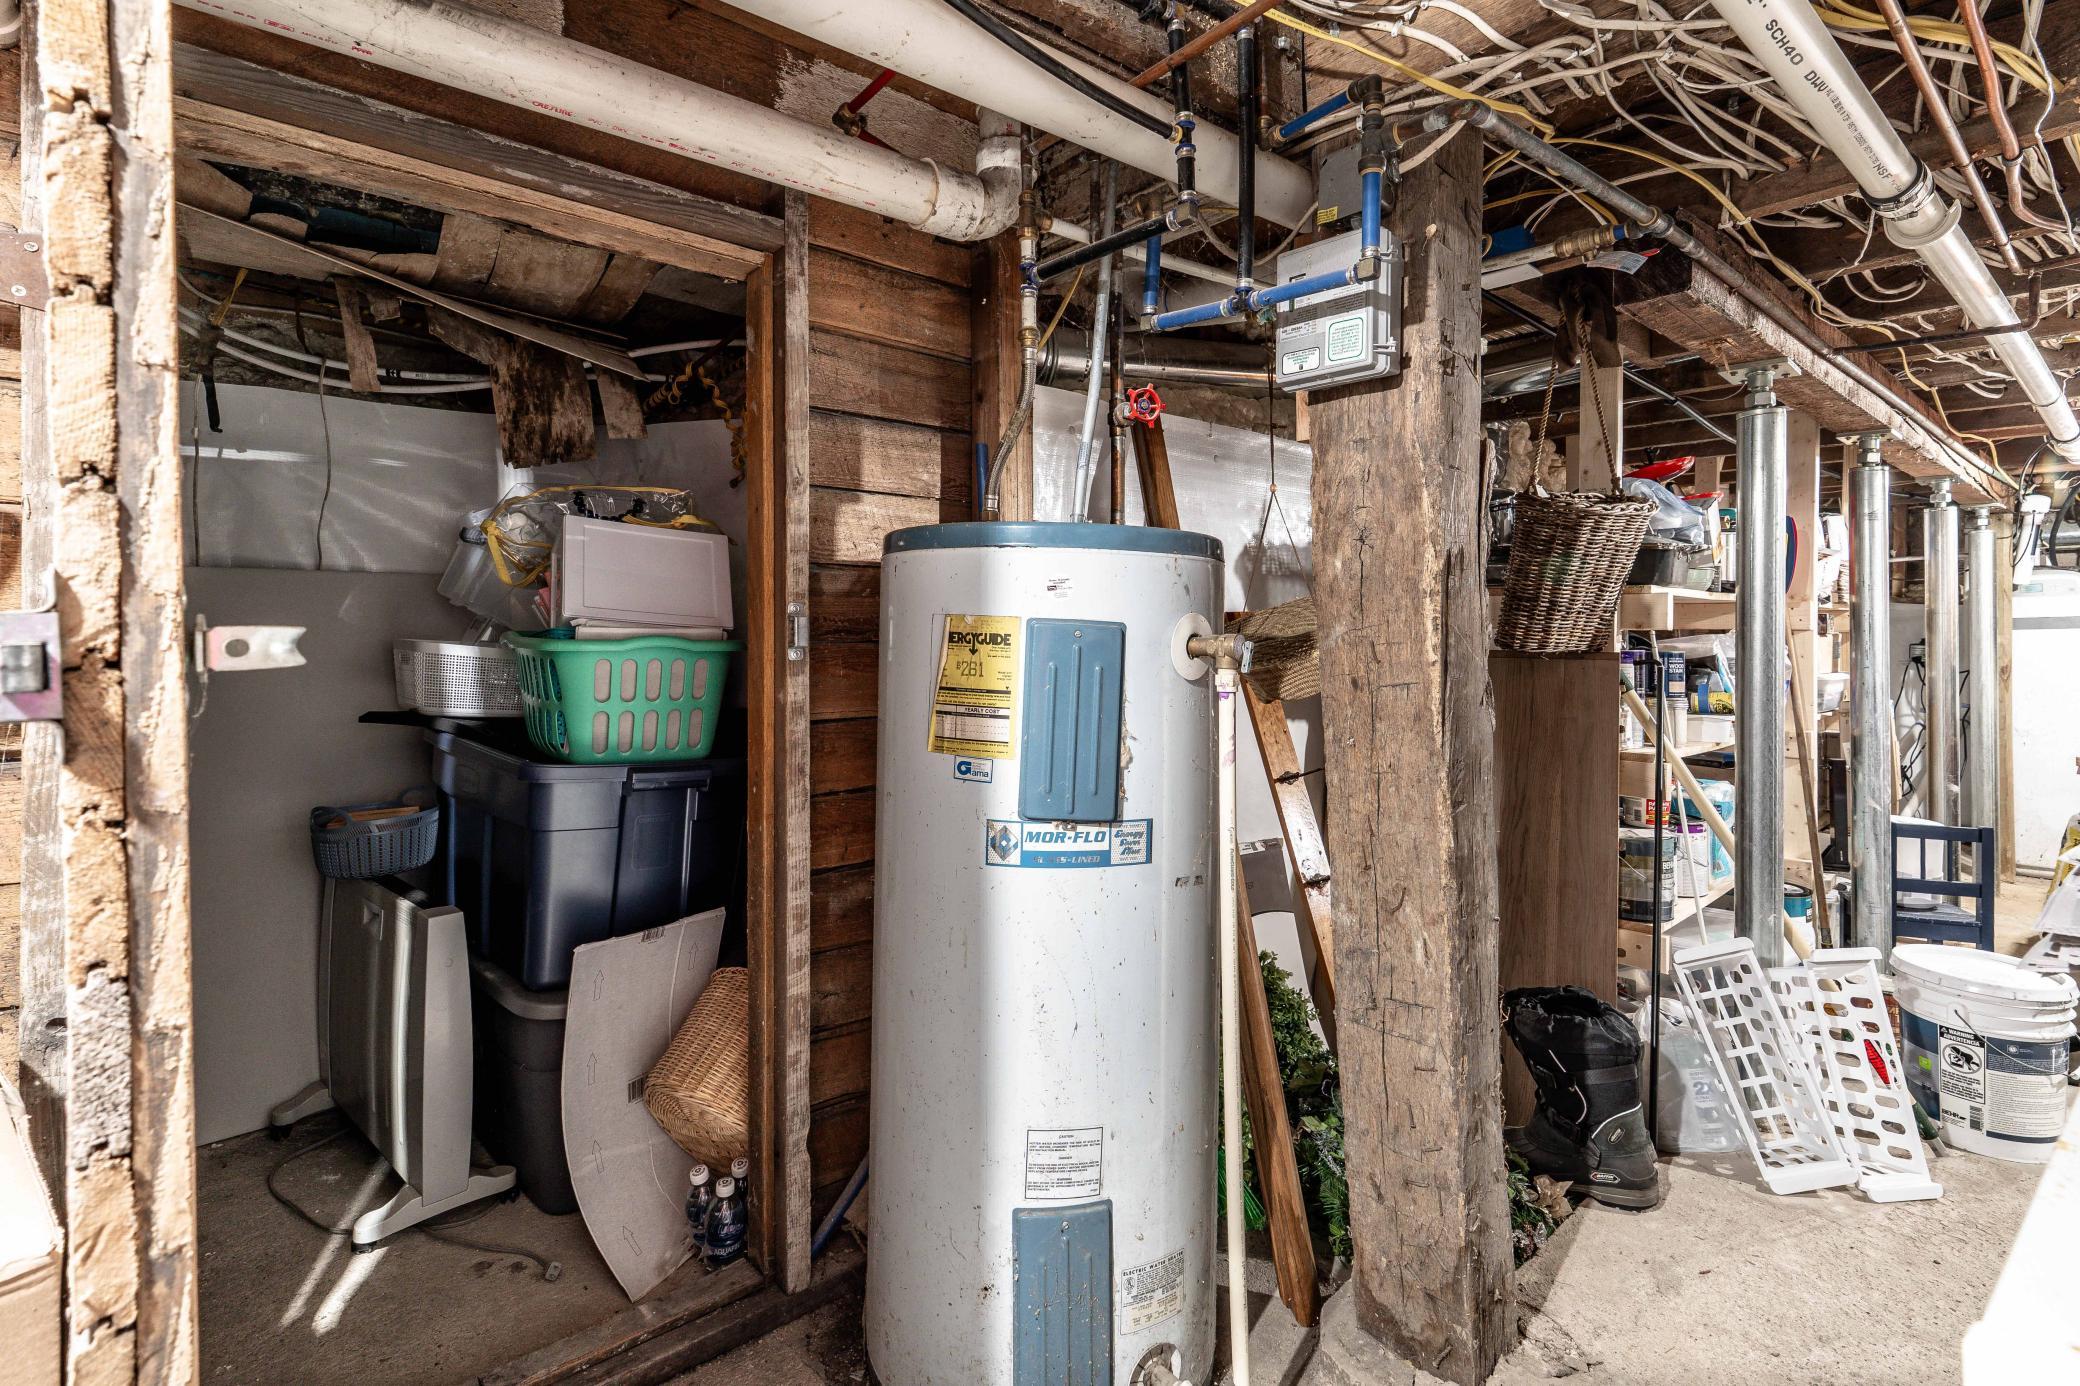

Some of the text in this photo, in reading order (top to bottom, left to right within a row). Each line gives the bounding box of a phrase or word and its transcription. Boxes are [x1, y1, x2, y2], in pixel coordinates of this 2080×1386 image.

[1765, 19, 1803, 65] SCH40
[949, 632, 1012, 647] ERGYGUIDE
[1024, 831, 1106, 843] MOR-FLO
[1114, 830, 1144, 839] Energy
[1943, 1033, 1980, 1047] ADVERTENCIA
[1949, 1029, 1974, 1039] WARNING
[1123, 1266, 1147, 1276] ELECTRIC
[1149, 1260, 1166, 1270] WATER
